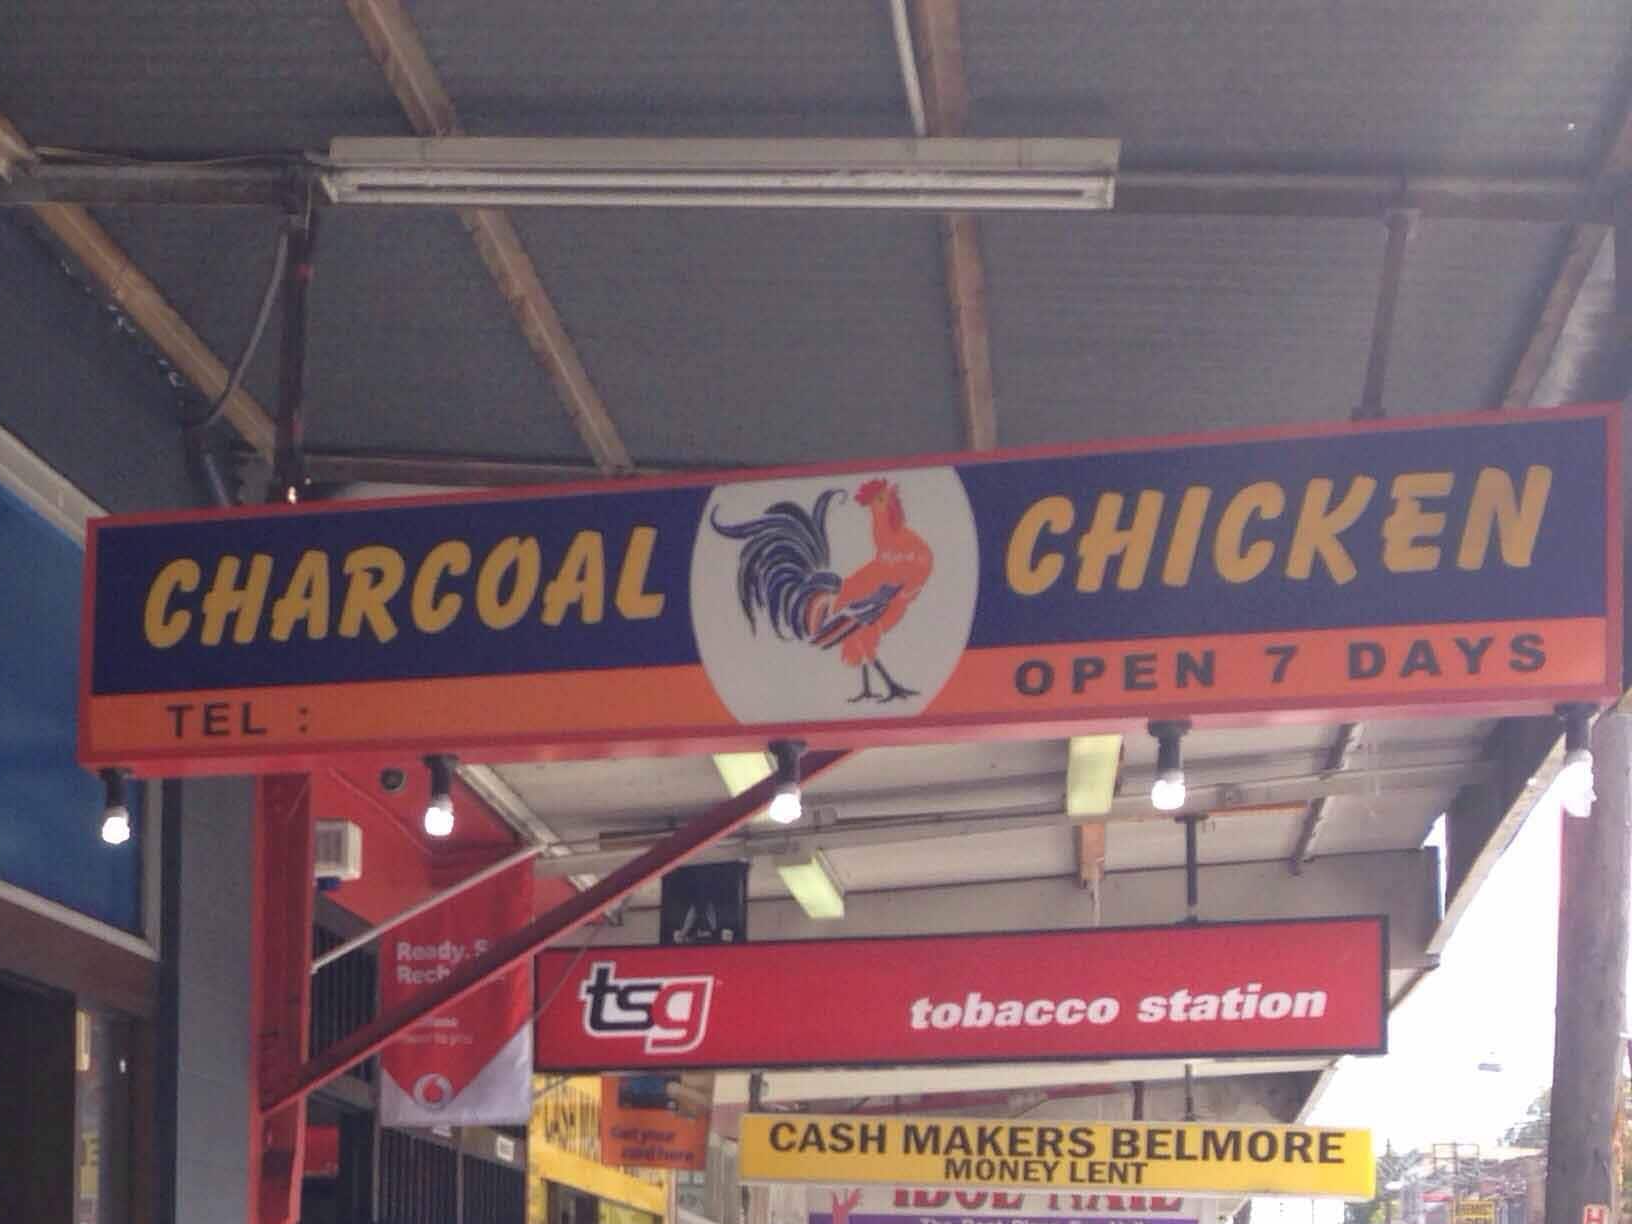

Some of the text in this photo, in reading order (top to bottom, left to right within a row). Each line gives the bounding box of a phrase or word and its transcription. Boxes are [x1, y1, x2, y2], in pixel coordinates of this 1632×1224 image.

[143, 464, 1553, 649] CHARCOAL CHICKEN
[1014, 633, 1548, 697] OPEN 7 DAYS
[168, 703, 268, 738] TEL
[580, 961, 715, 1054] tsg
[910, 983, 1328, 1029] tobacco station
[769, 1121, 1345, 1164] CASH MAKERS BELMORE
[943, 1158, 1148, 1184] MONEY LENT
